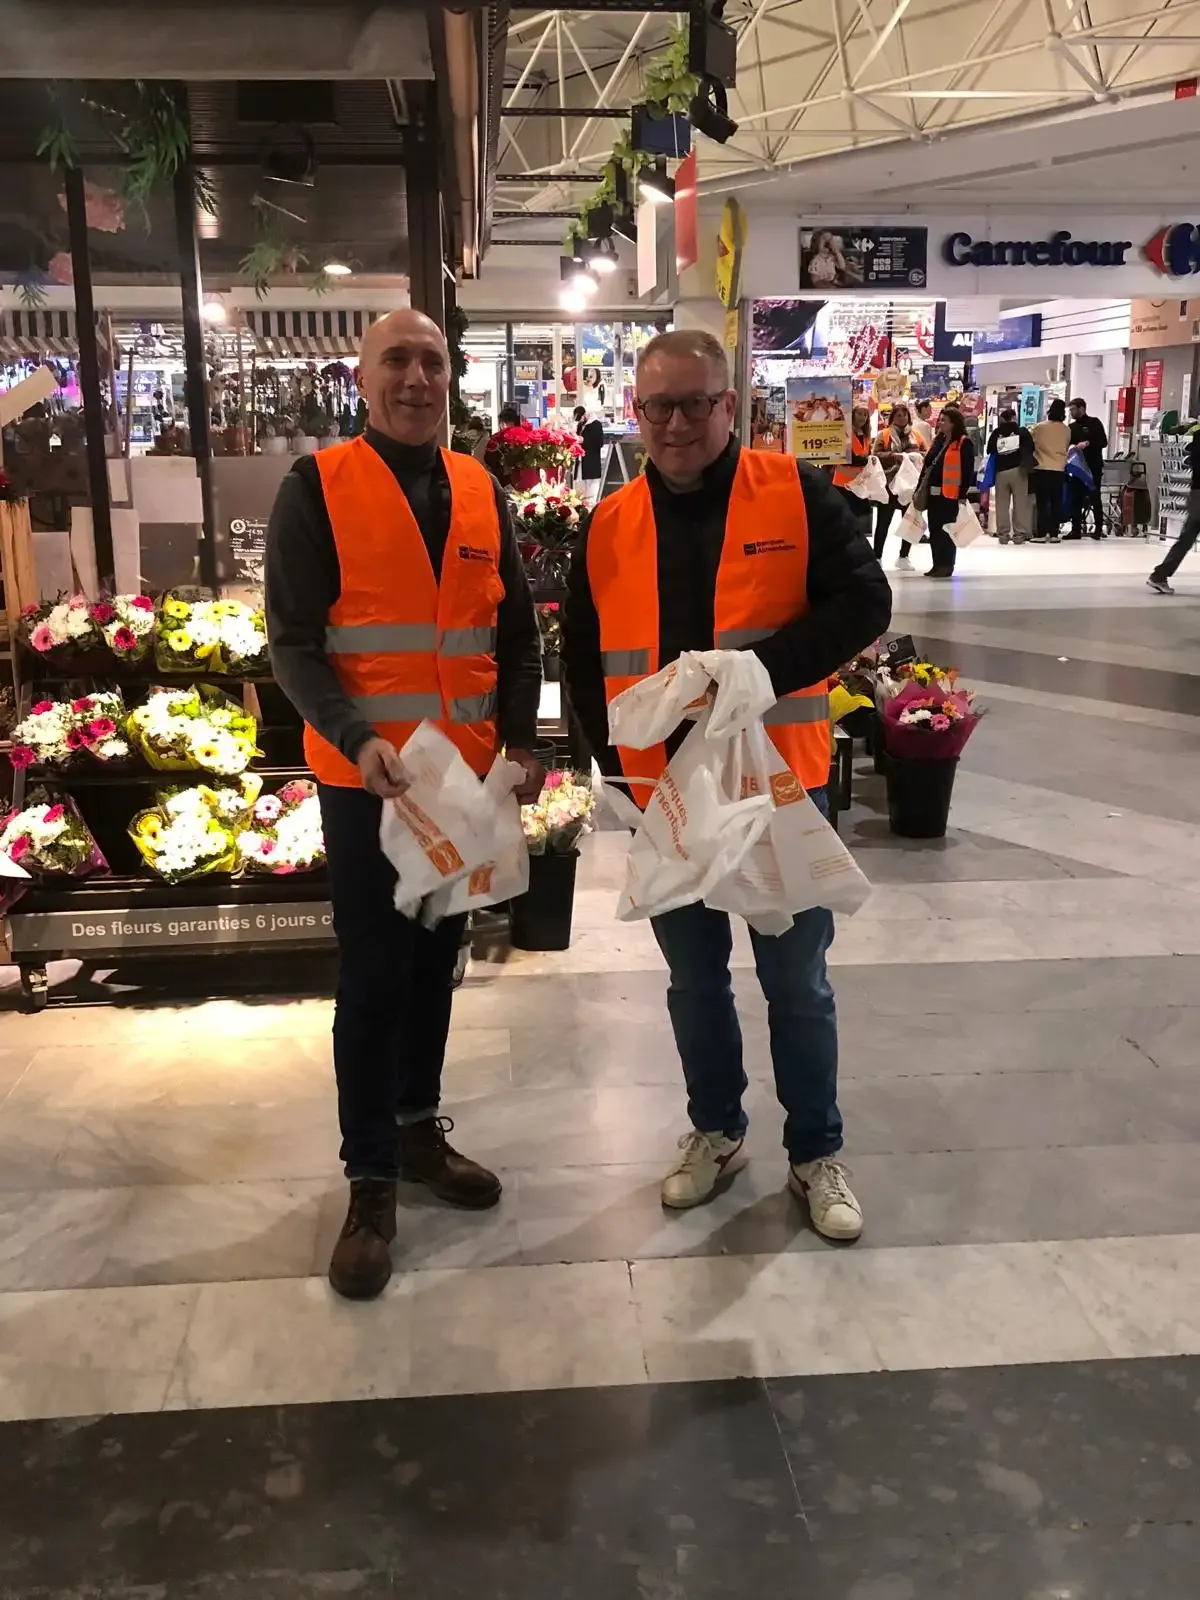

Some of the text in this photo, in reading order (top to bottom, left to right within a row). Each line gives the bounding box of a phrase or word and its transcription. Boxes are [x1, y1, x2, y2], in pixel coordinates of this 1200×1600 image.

[942, 230, 1133, 266] Carrefour
[71, 922, 107, 937] Des
[111, 920, 163, 936] fleurs
[168, 915, 250, 936] garanties
[255, 914, 266, 929] 6
[270, 914, 317, 931] jours
